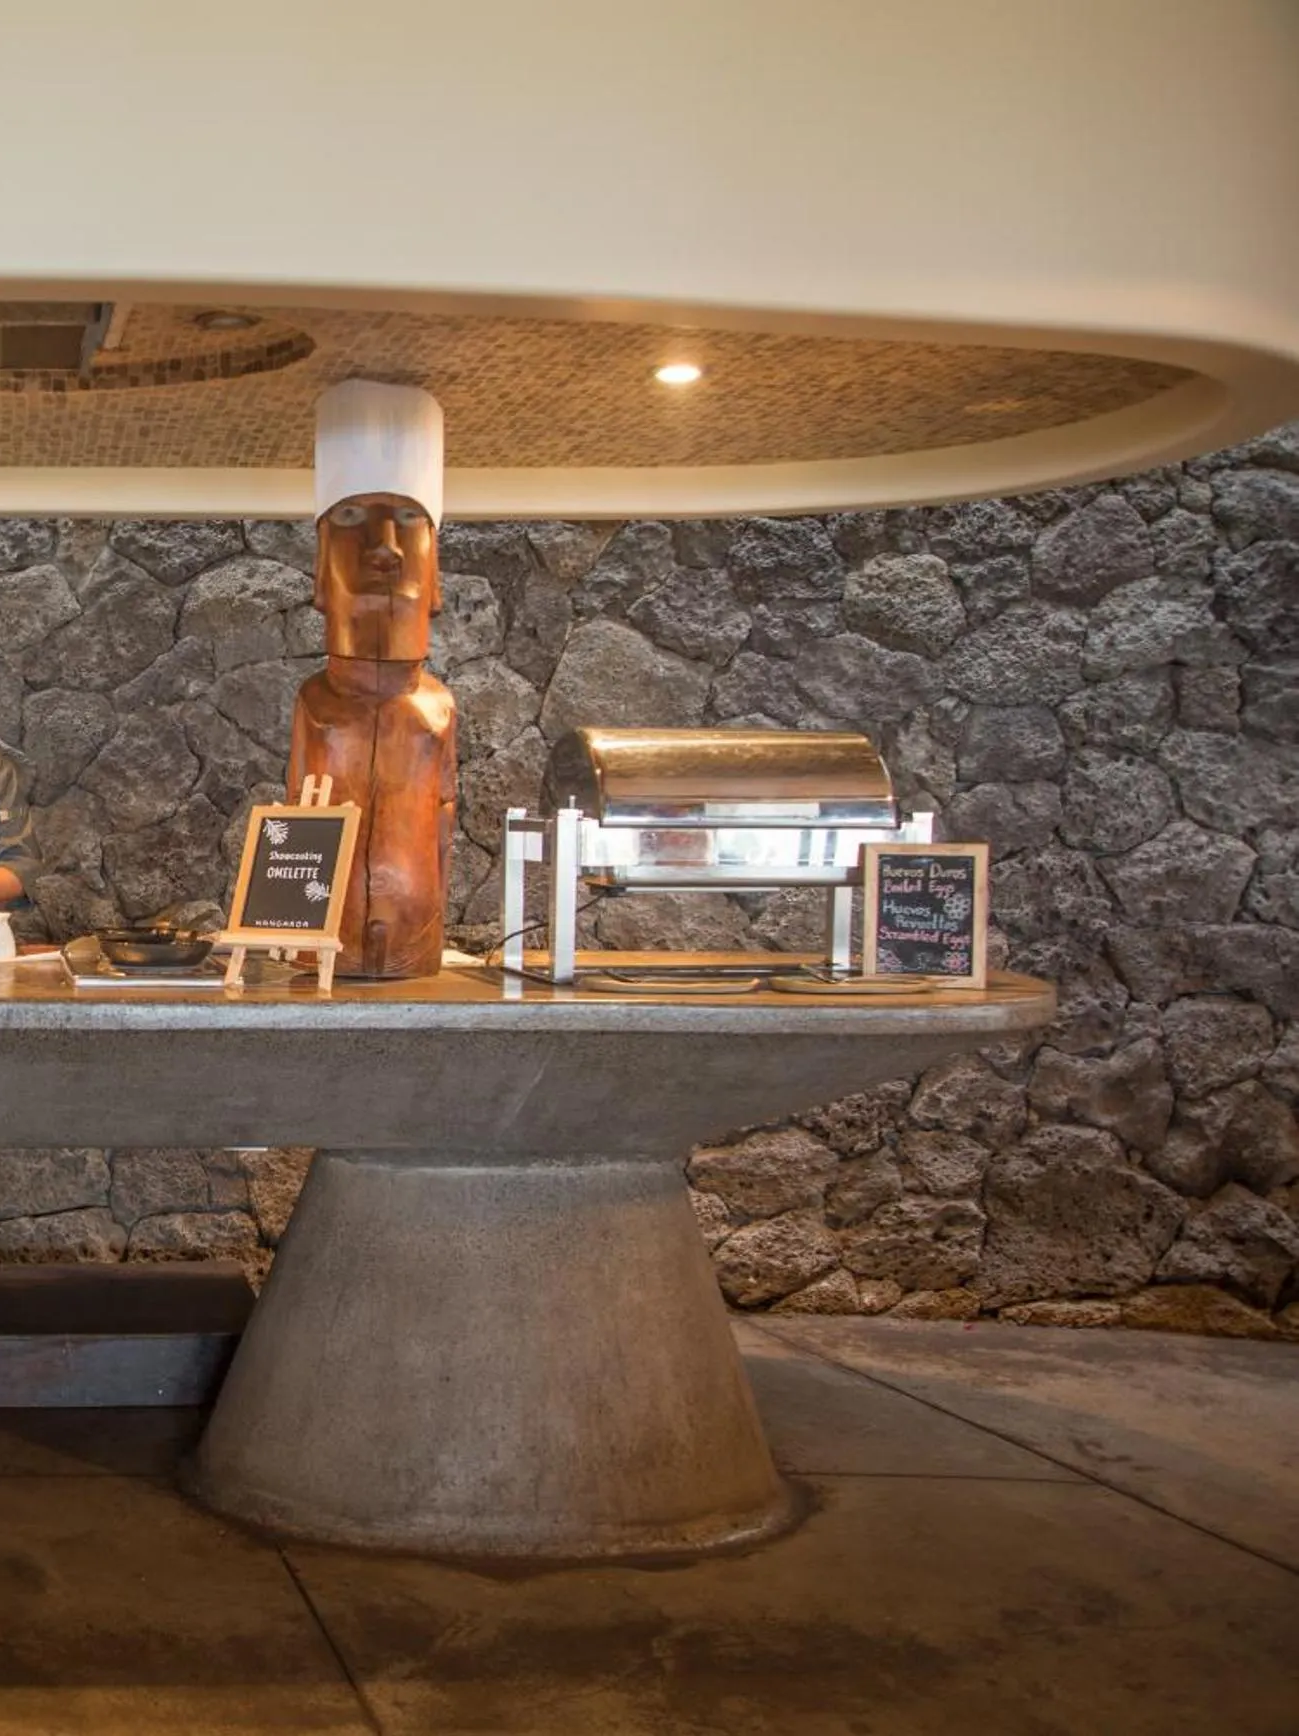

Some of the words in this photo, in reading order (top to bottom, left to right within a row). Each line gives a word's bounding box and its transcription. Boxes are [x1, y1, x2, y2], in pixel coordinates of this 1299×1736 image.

[269, 851, 322, 863] Showcooking
[267, 867, 320, 879] OMELETTE
[929, 863, 967, 879] Duros
[883, 880, 922, 893] Boiled
[929, 880, 955, 899] Eggs
[883, 900, 931, 917] Huevos
[879, 926, 940, 943] Scrambled
